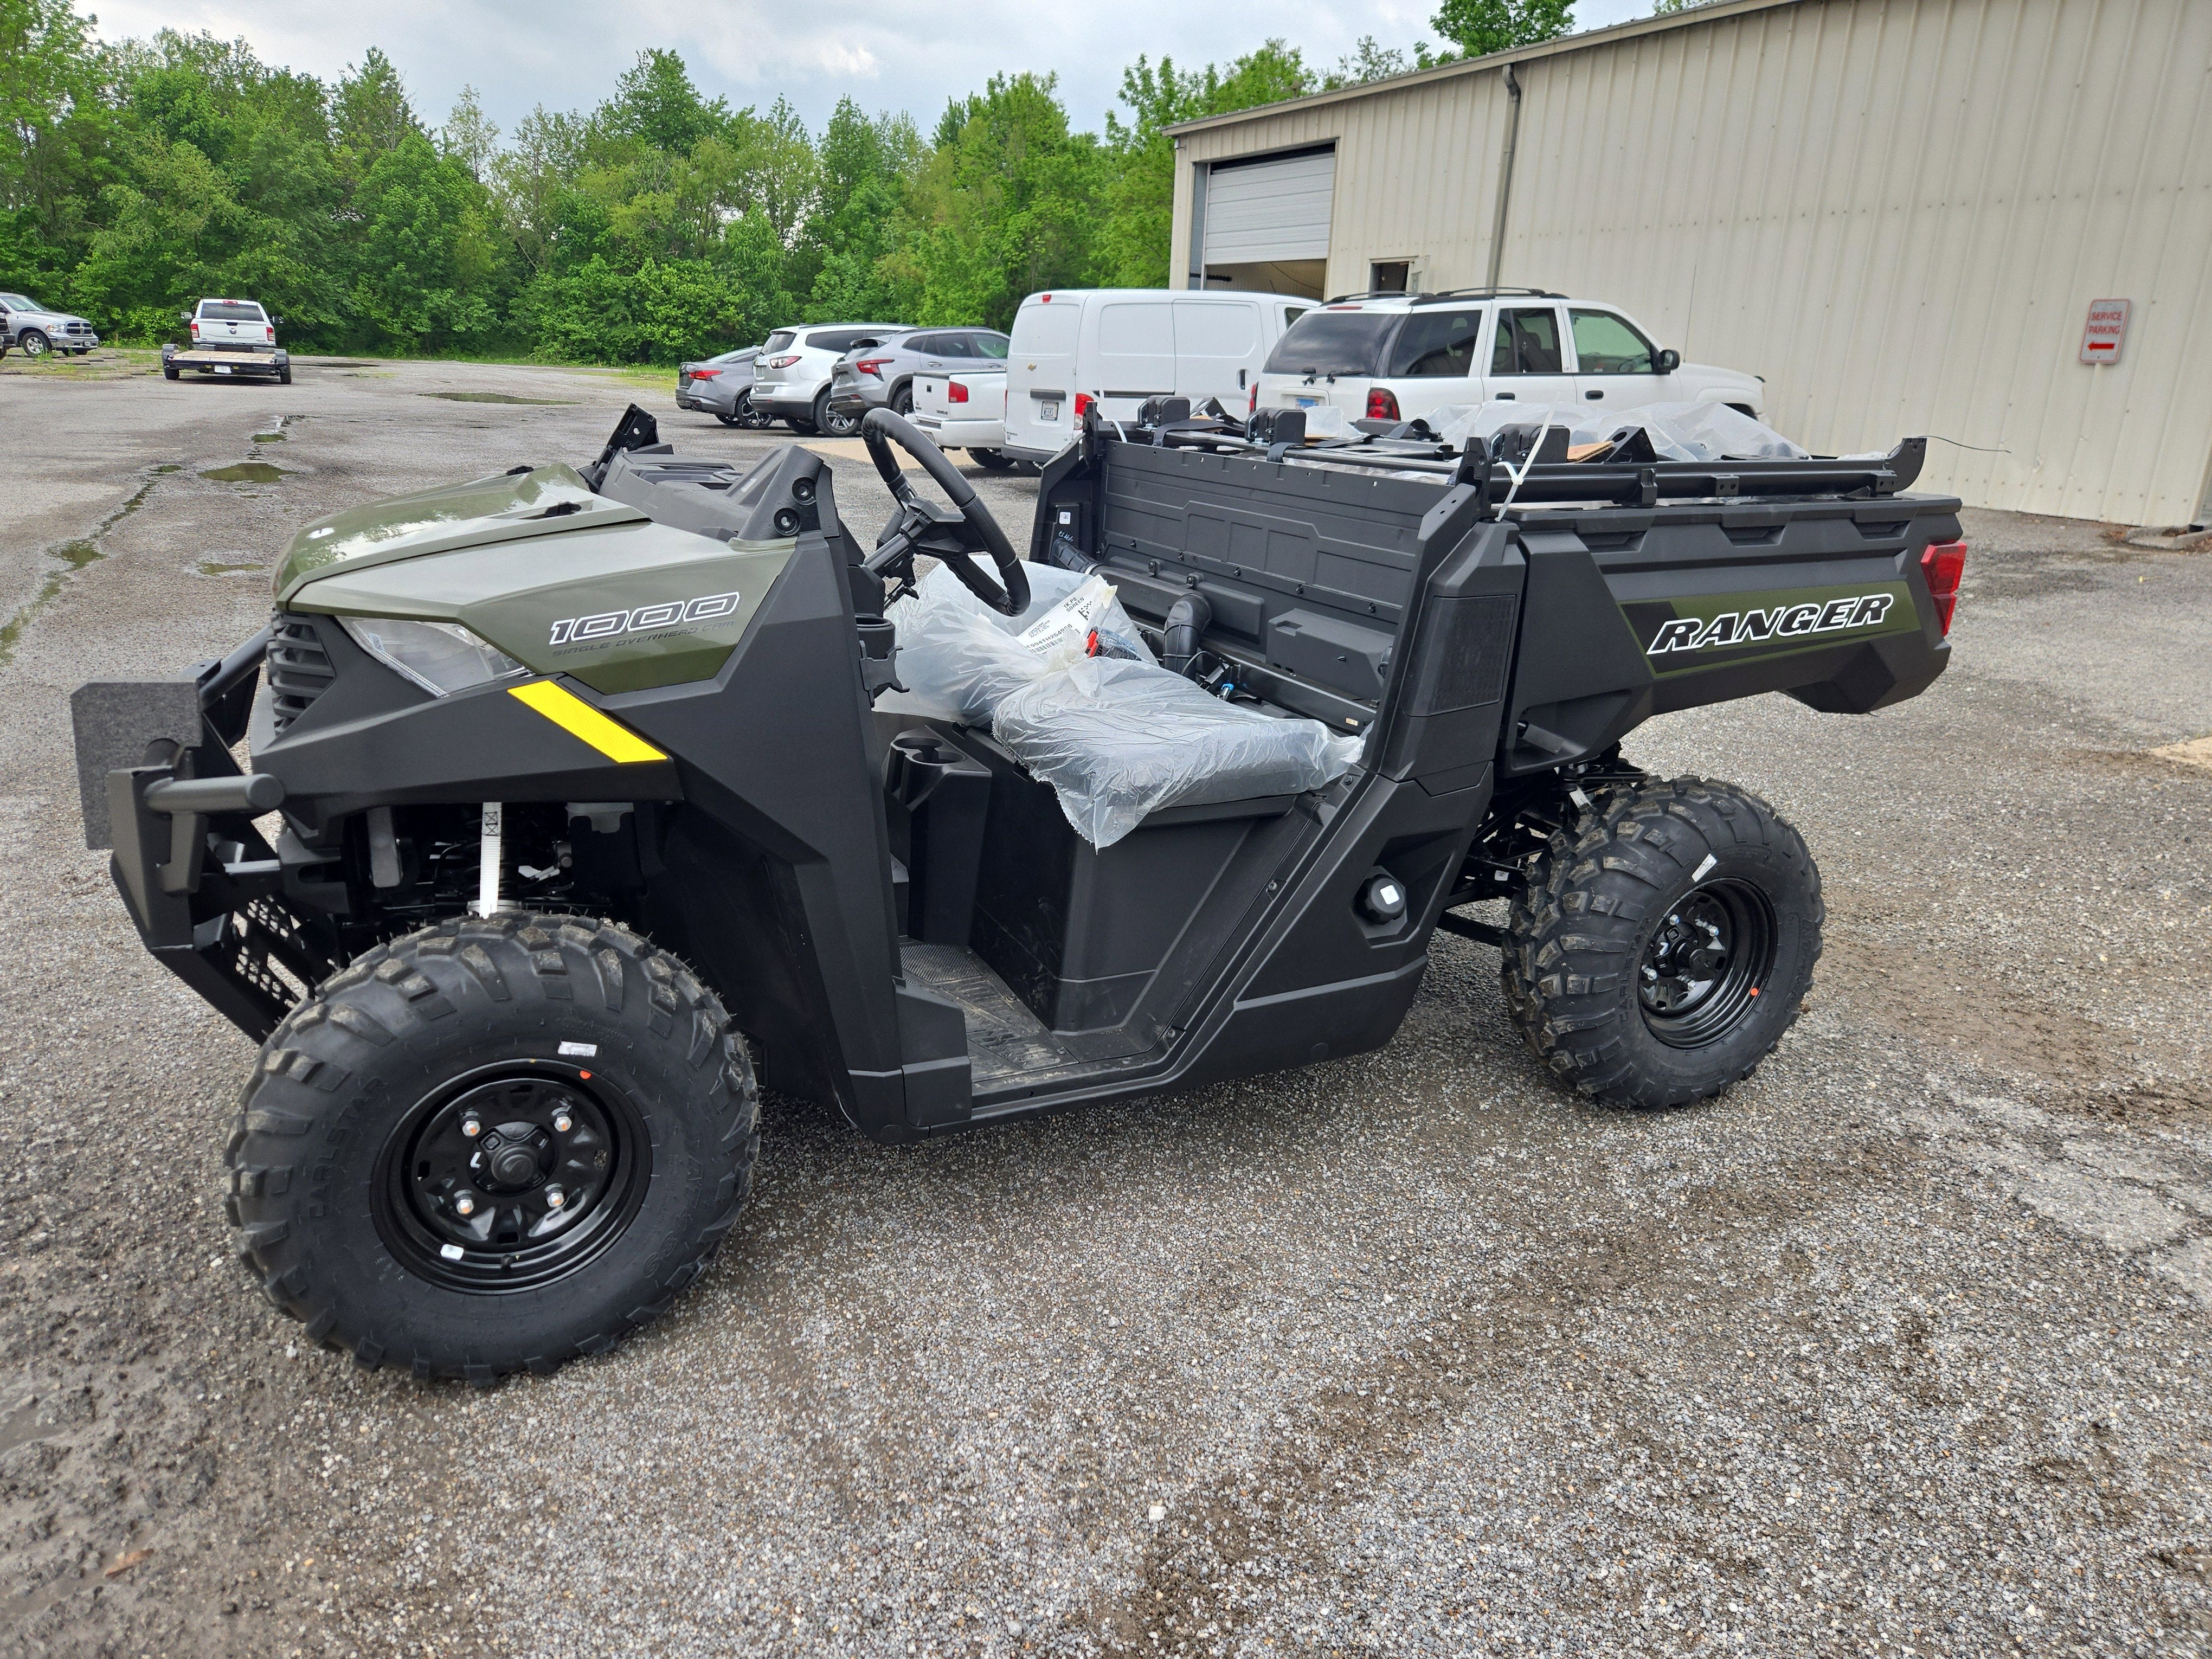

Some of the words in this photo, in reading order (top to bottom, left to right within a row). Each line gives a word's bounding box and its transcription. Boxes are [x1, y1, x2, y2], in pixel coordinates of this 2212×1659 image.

[2088, 325, 2121, 335] PARKING
[2091, 311, 2123, 321] SERVICE
[549, 591, 741, 645] 1000
[1645, 593, 1894, 655] RANGER
[552, 642, 610, 657] SINGLE
[616, 628, 698, 647] OVERHEAD
[702, 620, 735, 632] CAM
